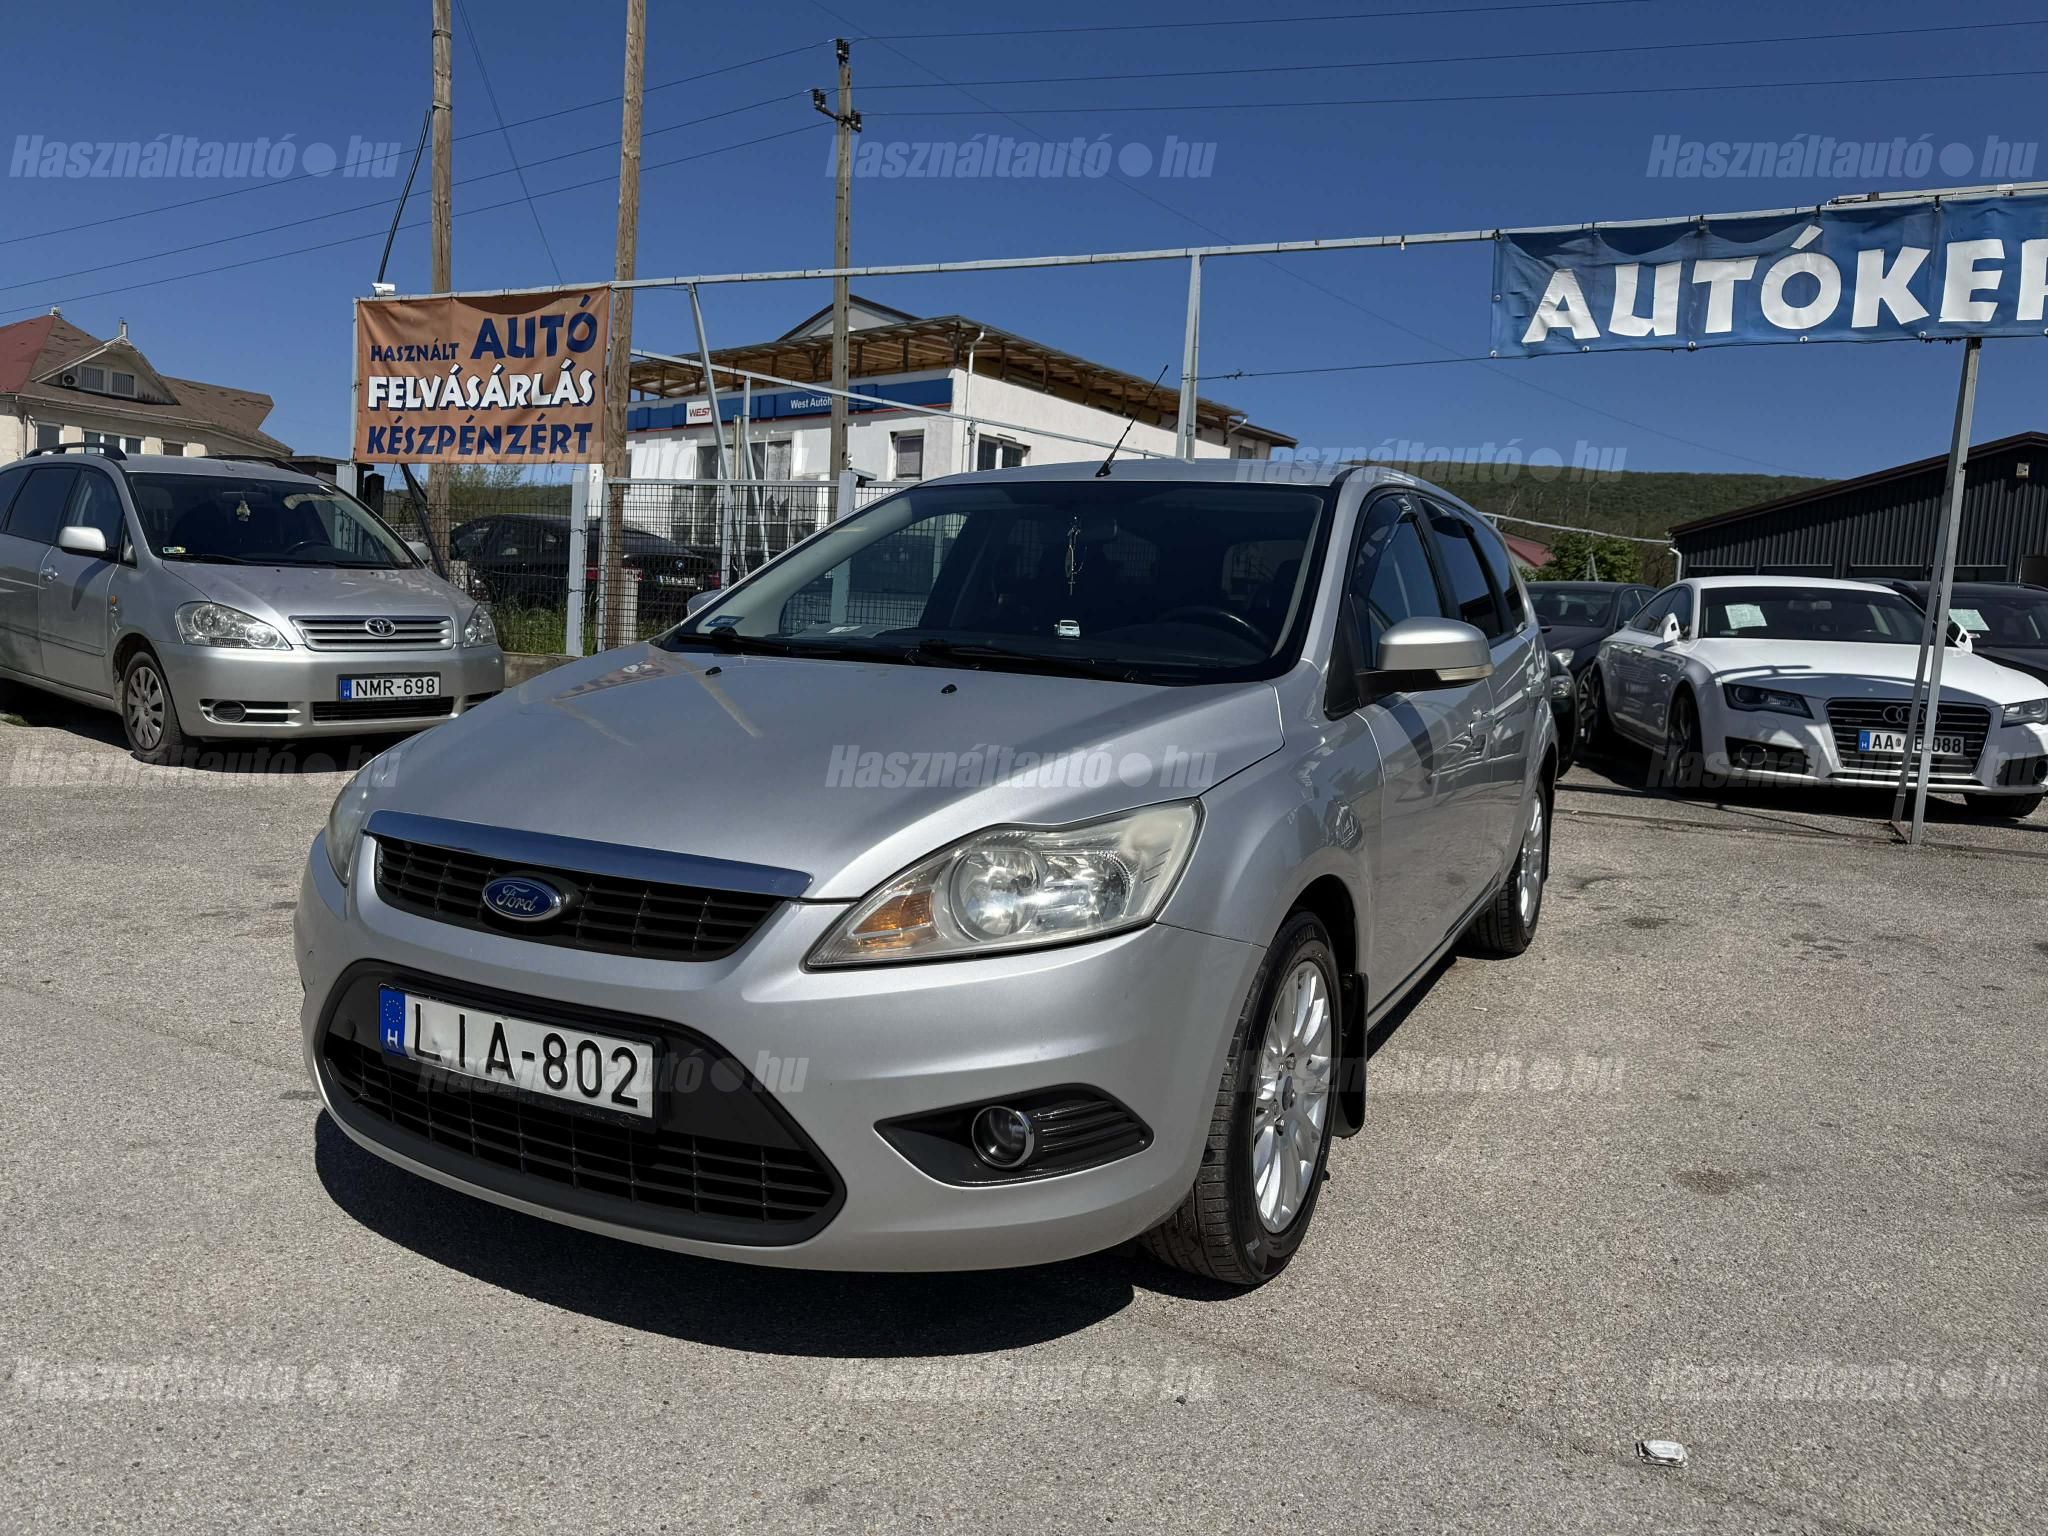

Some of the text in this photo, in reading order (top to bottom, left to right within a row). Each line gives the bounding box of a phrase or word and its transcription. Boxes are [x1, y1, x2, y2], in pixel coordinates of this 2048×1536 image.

[371, 294, 598, 362] HASZNÁLT AUTÓ
[368, 358, 595, 411] FELVÁSÁRLÁS
[790, 399, 809, 409] West
[366, 413, 593, 456] KÉSZPÉNZÉRT
[355, 678, 436, 697] NMR-698
[496, 884, 539, 912] Ford
[386, 1029, 399, 1048] H
[414, 1003, 639, 1108] LIA-802
